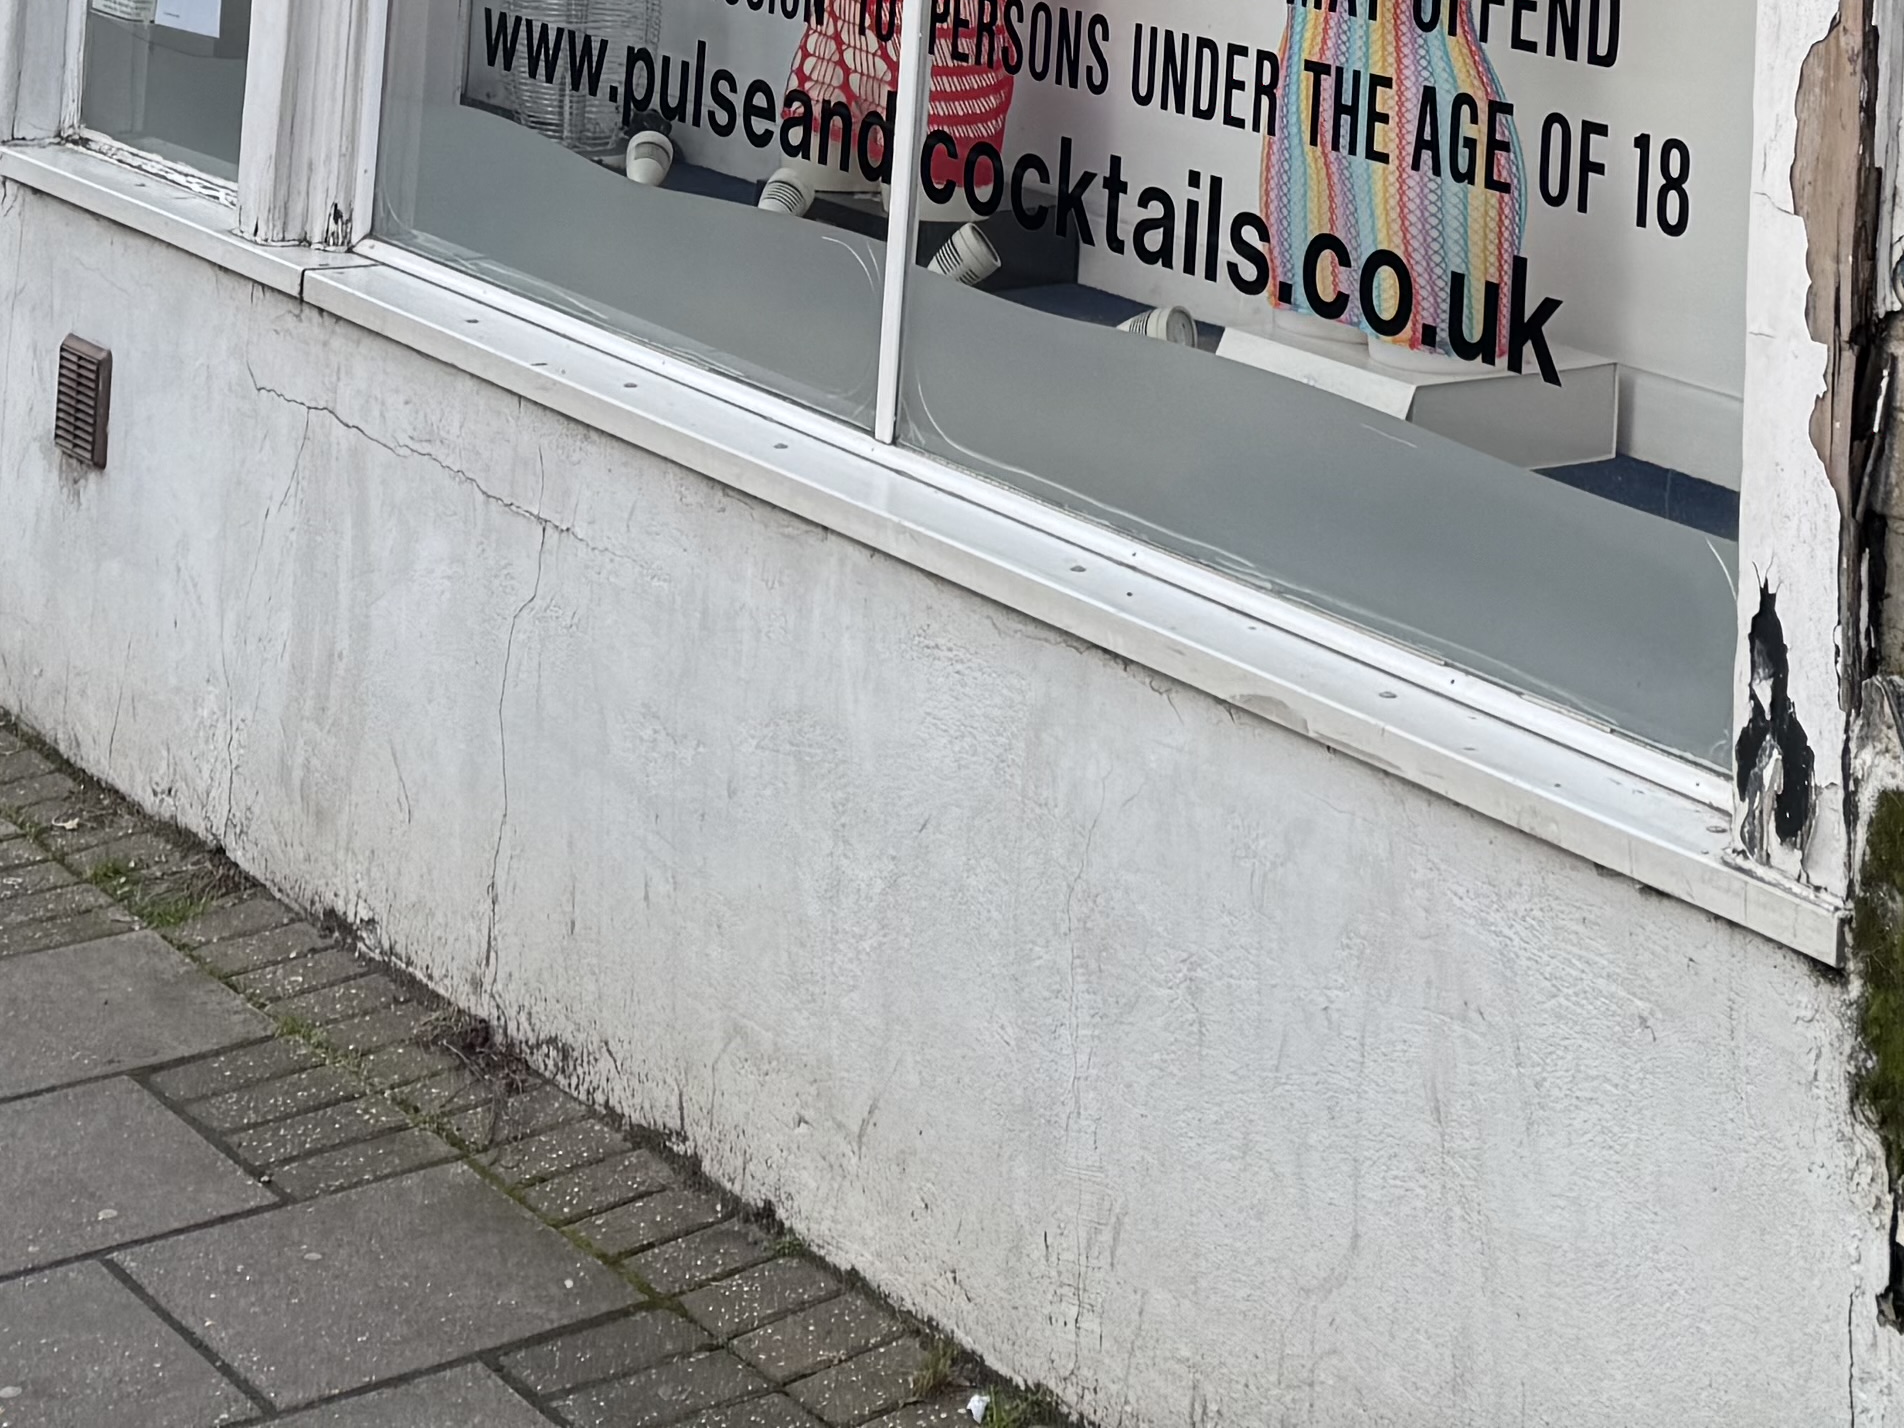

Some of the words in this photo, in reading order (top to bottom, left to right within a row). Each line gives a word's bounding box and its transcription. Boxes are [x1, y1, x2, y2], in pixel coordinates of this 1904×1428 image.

[483, 7, 1564, 388] www.pulseandcocktails.co.uk
[1132, 21, 1280, 137] UNDER
[1303, 59, 1394, 165] THE
[1411, 83, 1515, 196] AGE
[1538, 111, 1610, 215] OF
[1632, 131, 1692, 238] 18
